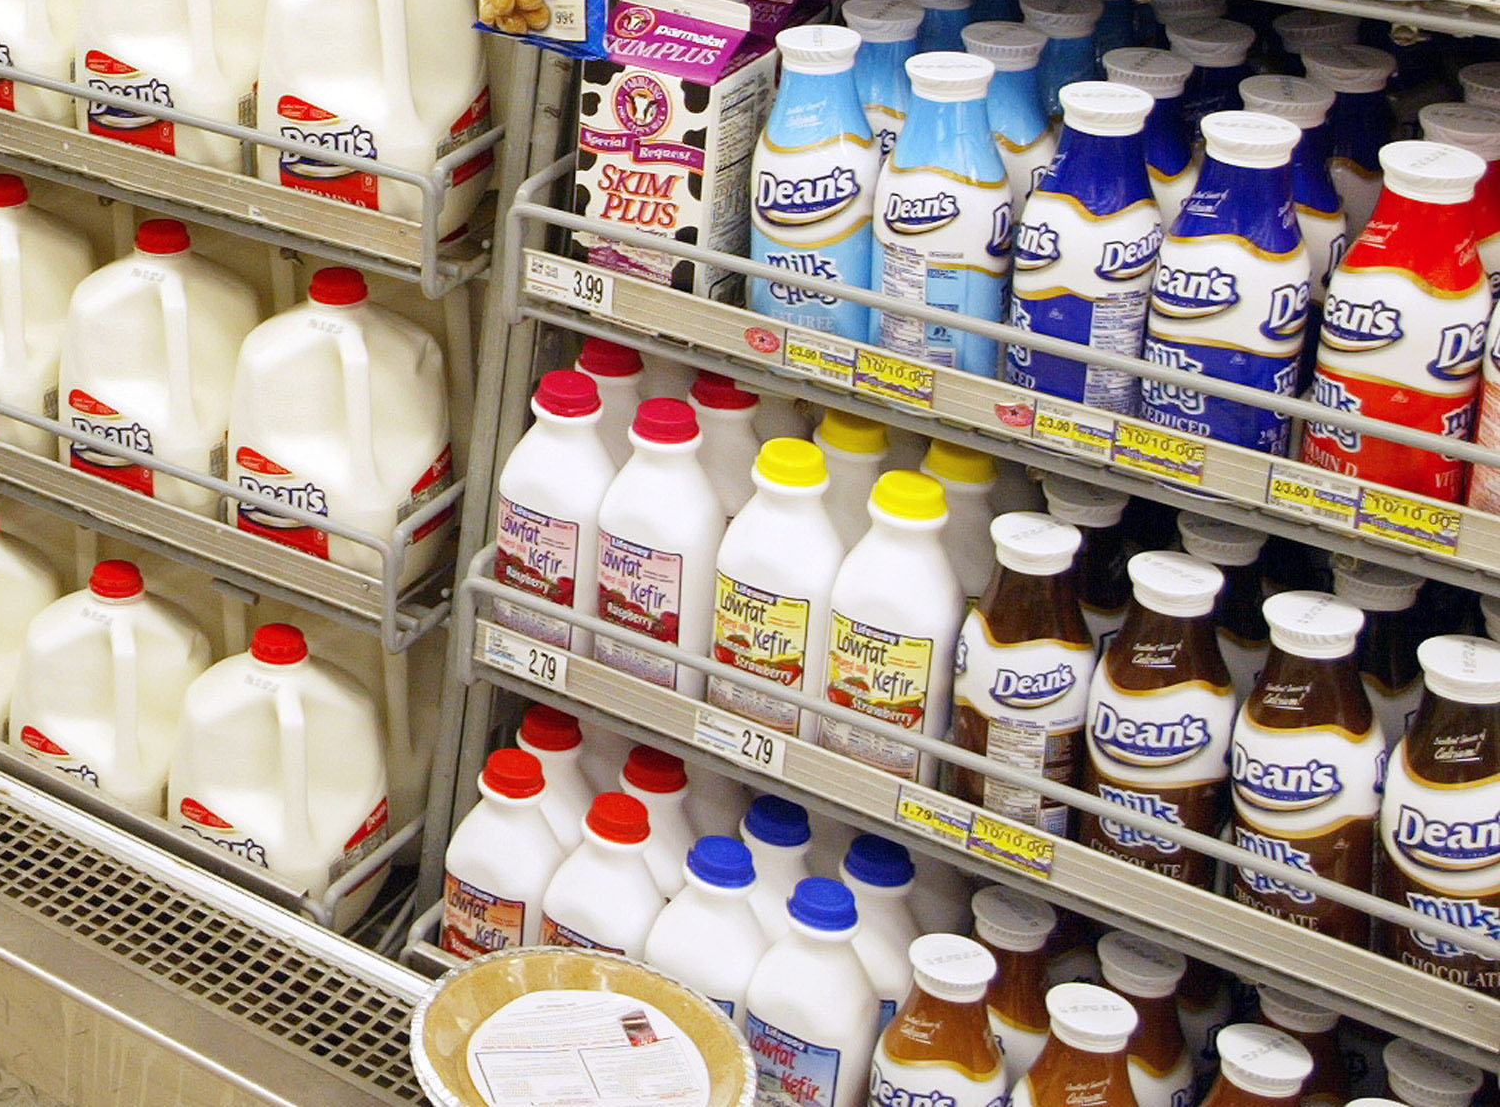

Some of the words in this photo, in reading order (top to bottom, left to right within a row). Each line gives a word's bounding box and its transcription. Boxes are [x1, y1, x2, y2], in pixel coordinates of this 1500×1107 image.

[655, 25, 727, 49] parmalat
[653, 41, 718, 67] PLUS
[88, 79, 172, 110] Dean's
[280, 124, 376, 162] Dean's
[585, 133, 626, 149] Special
[639, 146, 692, 163] Request
[599, 163, 684, 198] SKIM
[758, 168, 860, 207] Dean's
[600, 196, 678, 227] PLUS
[885, 192, 959, 220] Dean's
[767, 252, 832, 276] milk
[573, 271, 605, 301] 3.99
[73, 416, 152, 453] Dean's
[239, 473, 326, 513] Dean's
[528, 547, 563, 572] Kefir
[630, 580, 666, 609] Kefir
[752, 626, 792, 658] Kefir
[528, 648, 557, 681] 2.79
[992, 662, 1075, 698] Dean's
[872, 667, 914, 696] Kefir
[1094, 702, 1210, 749] Dean's
[741, 730, 774, 765] 2.79
[1232, 742, 1341, 796] Dean's
[901, 801, 933, 822] 1.79
[1099, 786, 1179, 829] milk
[1236, 827, 1311, 869] milk
[1408, 892, 1496, 935] milk
[780, 1071, 819, 1100] Kefir
